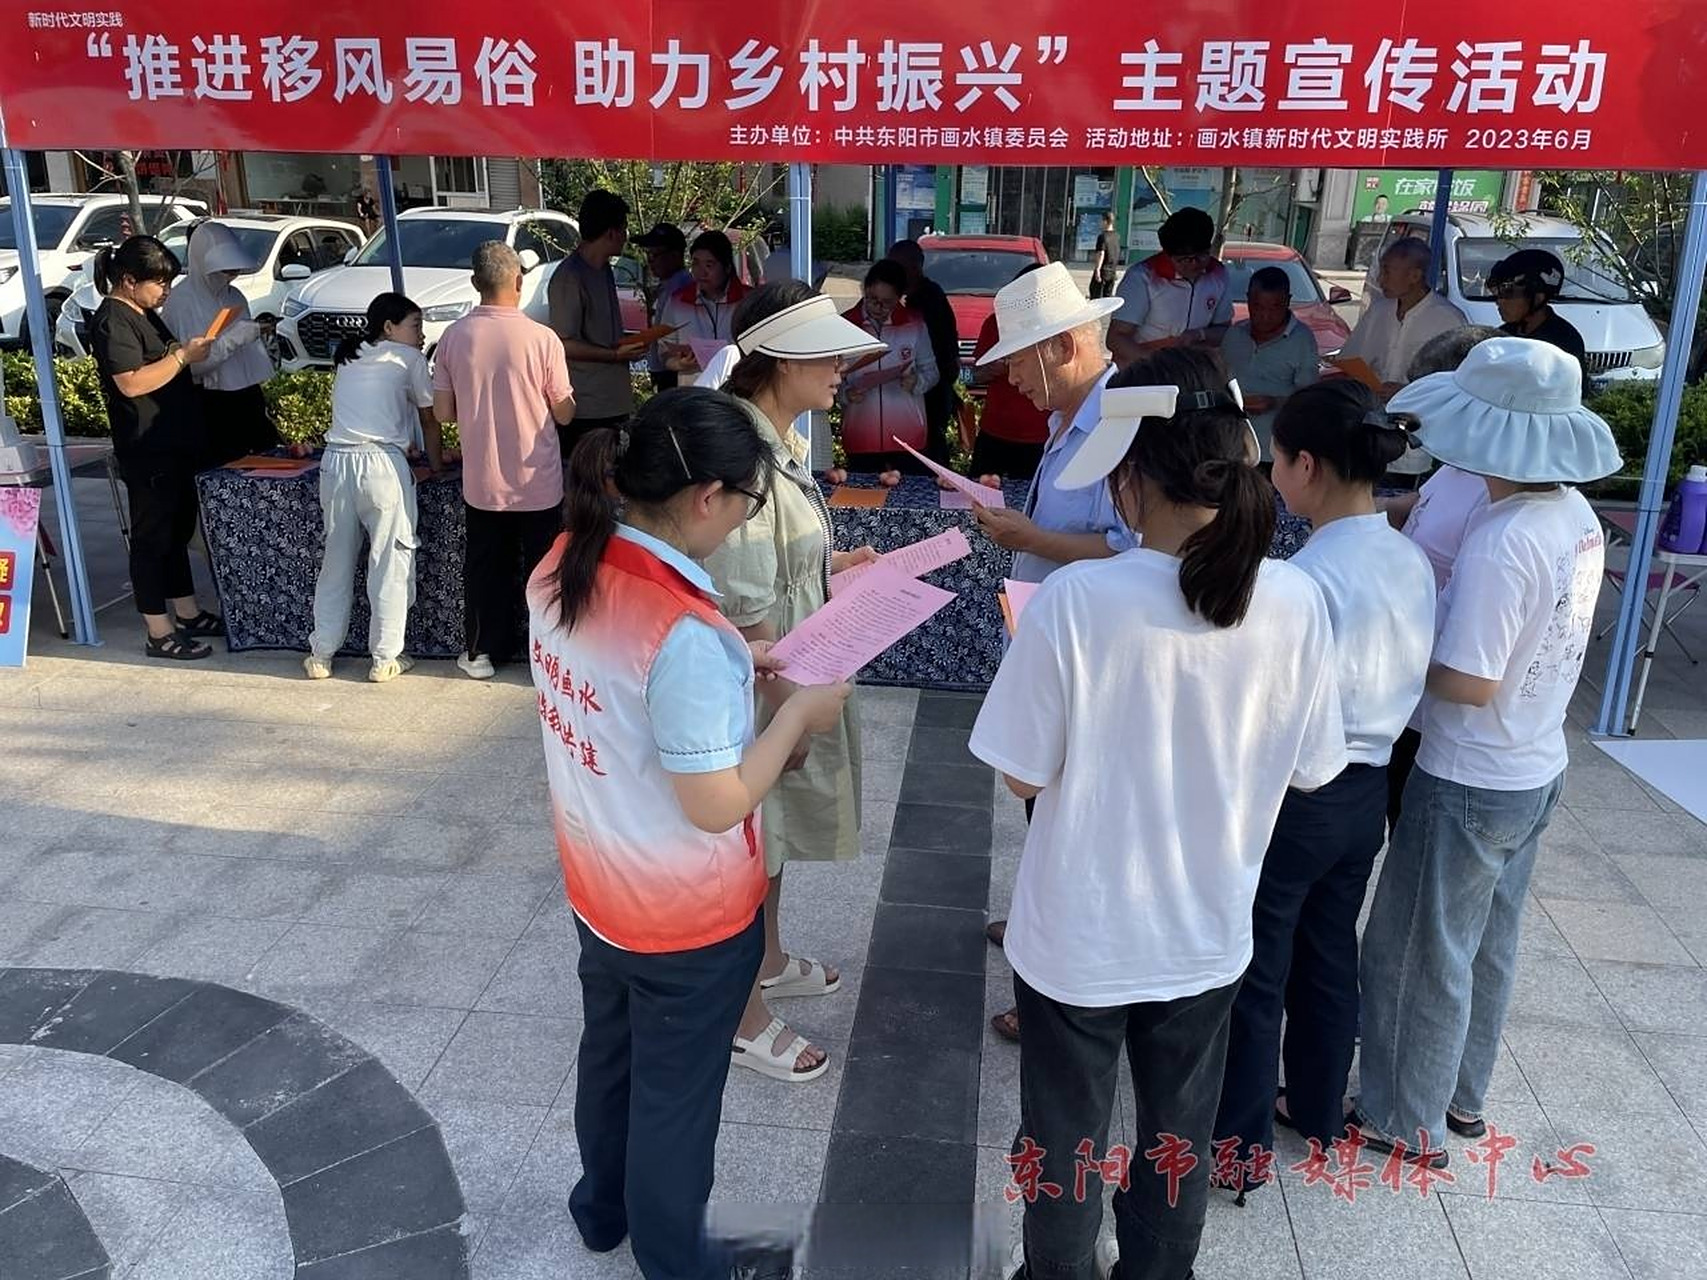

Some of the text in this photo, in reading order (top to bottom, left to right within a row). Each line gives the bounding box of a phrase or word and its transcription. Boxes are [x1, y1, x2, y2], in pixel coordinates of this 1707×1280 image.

[28, 12, 124, 28] 新时代文明实践
[86, 32, 1608, 115] “推进移风易俗 助力乡村振兴” 主题宣传活动
[1465, 129, 1593, 151] 2023年6月
